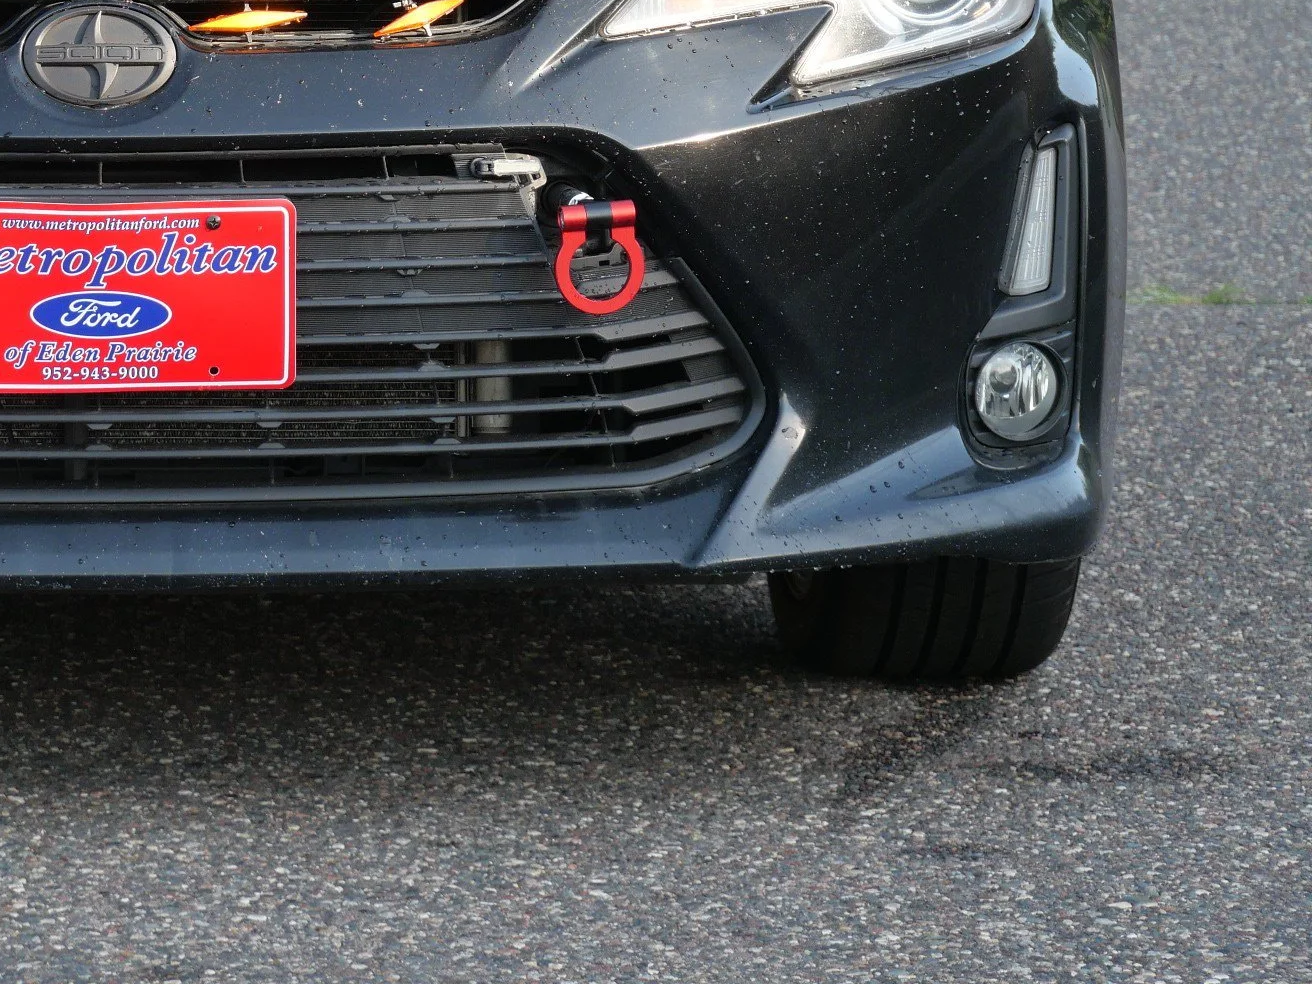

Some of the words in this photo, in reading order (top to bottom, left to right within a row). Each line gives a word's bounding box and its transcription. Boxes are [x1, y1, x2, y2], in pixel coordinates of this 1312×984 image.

[1, 215, 200, 235] www.metropolitanford.com
[59, 298, 141, 328] Ford
[3, 340, 36, 369] of
[35, 341, 101, 363] Eden
[103, 340, 197, 363] Prairie
[41, 366, 159, 381] 952-943-9000
